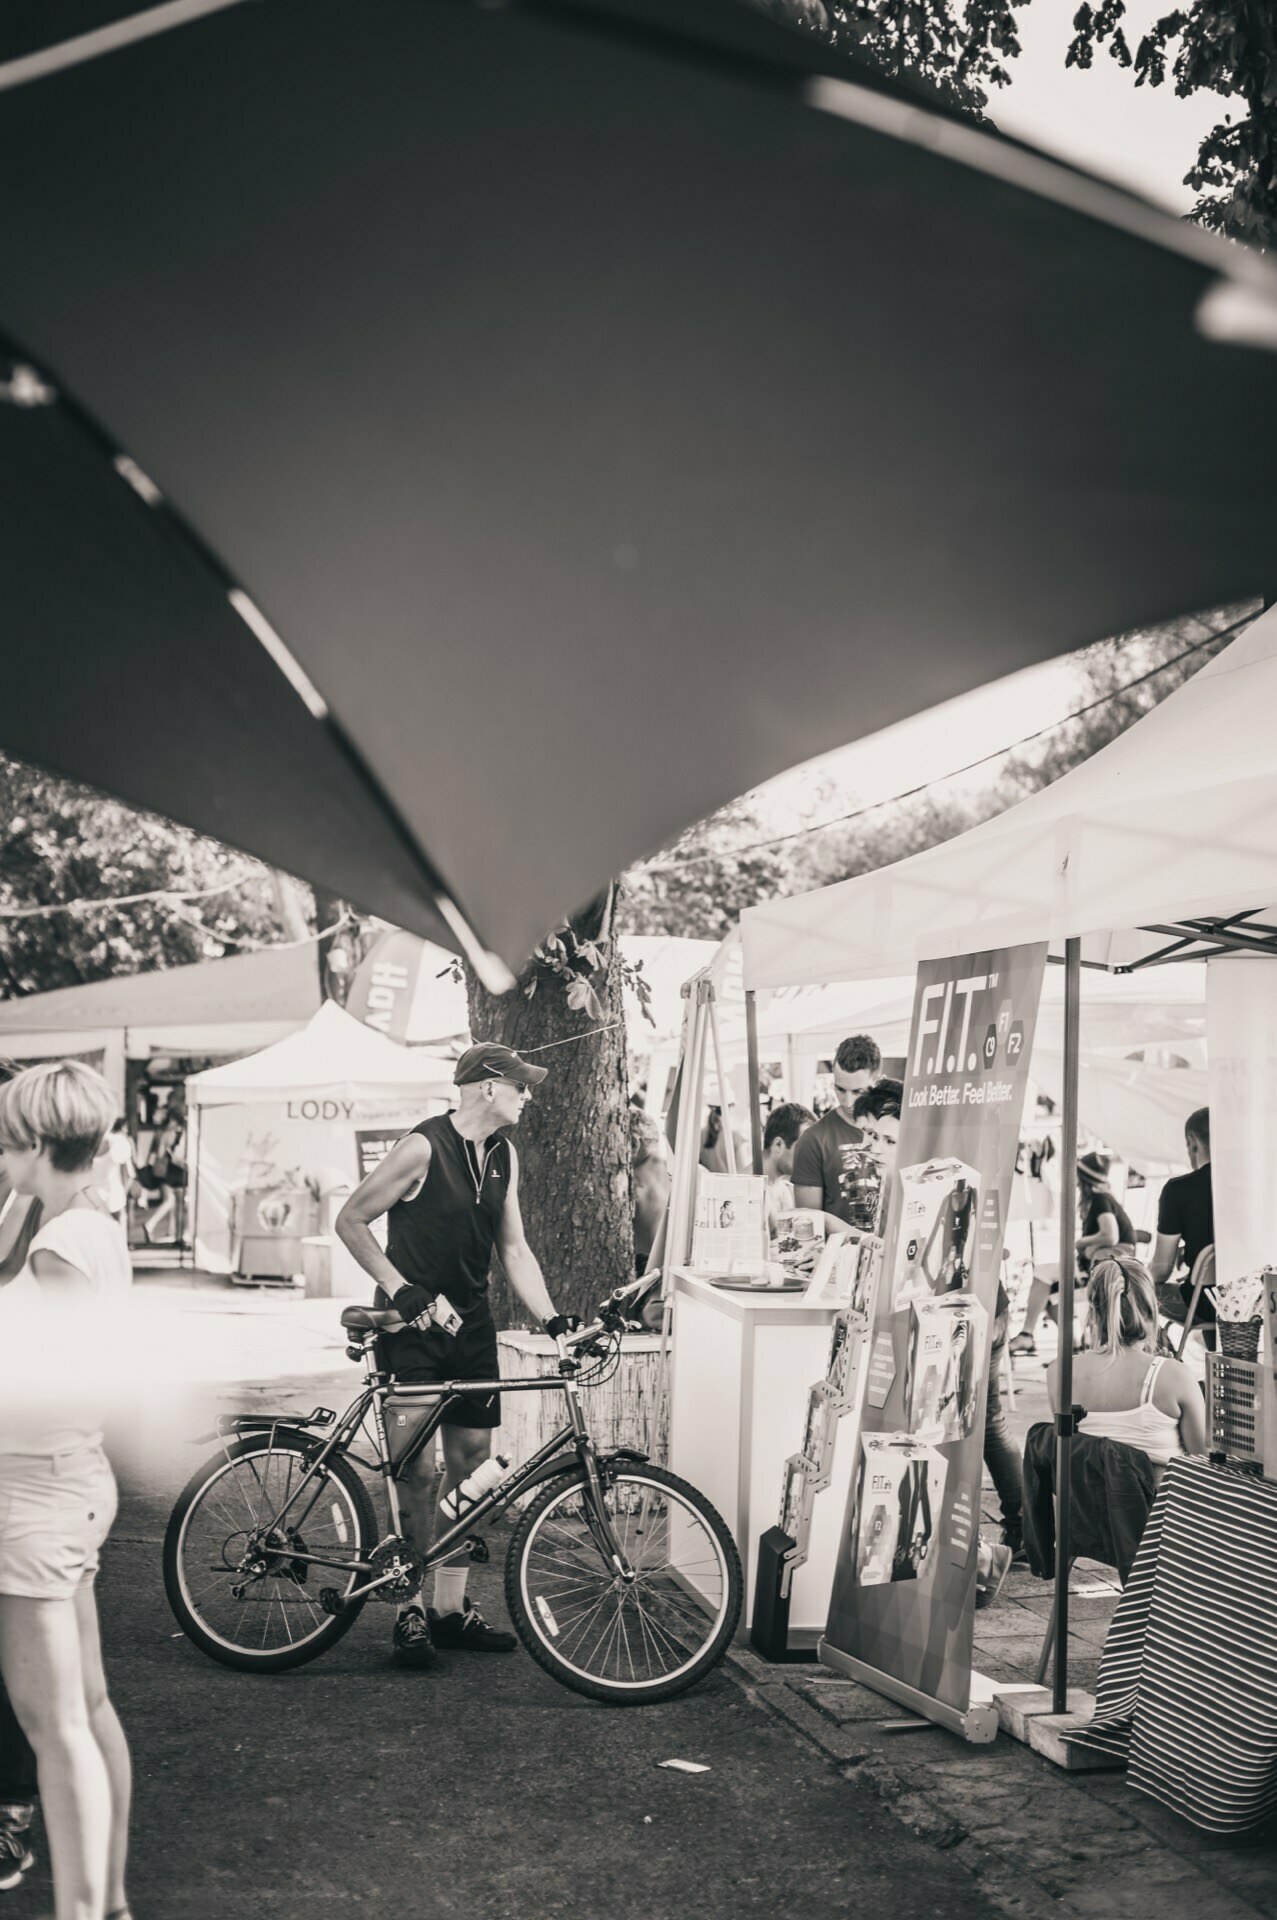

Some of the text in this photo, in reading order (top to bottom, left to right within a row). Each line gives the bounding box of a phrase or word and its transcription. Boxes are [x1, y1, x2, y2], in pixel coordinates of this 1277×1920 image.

[912, 976, 988, 1076] F.I.T.
[998, 1011, 1010, 1033] F1
[1007, 1033, 1022, 1054] F2
[908, 1081, 1013, 1108] Look Better. Feel Better.
[286, 1101, 355, 1120] LODY
